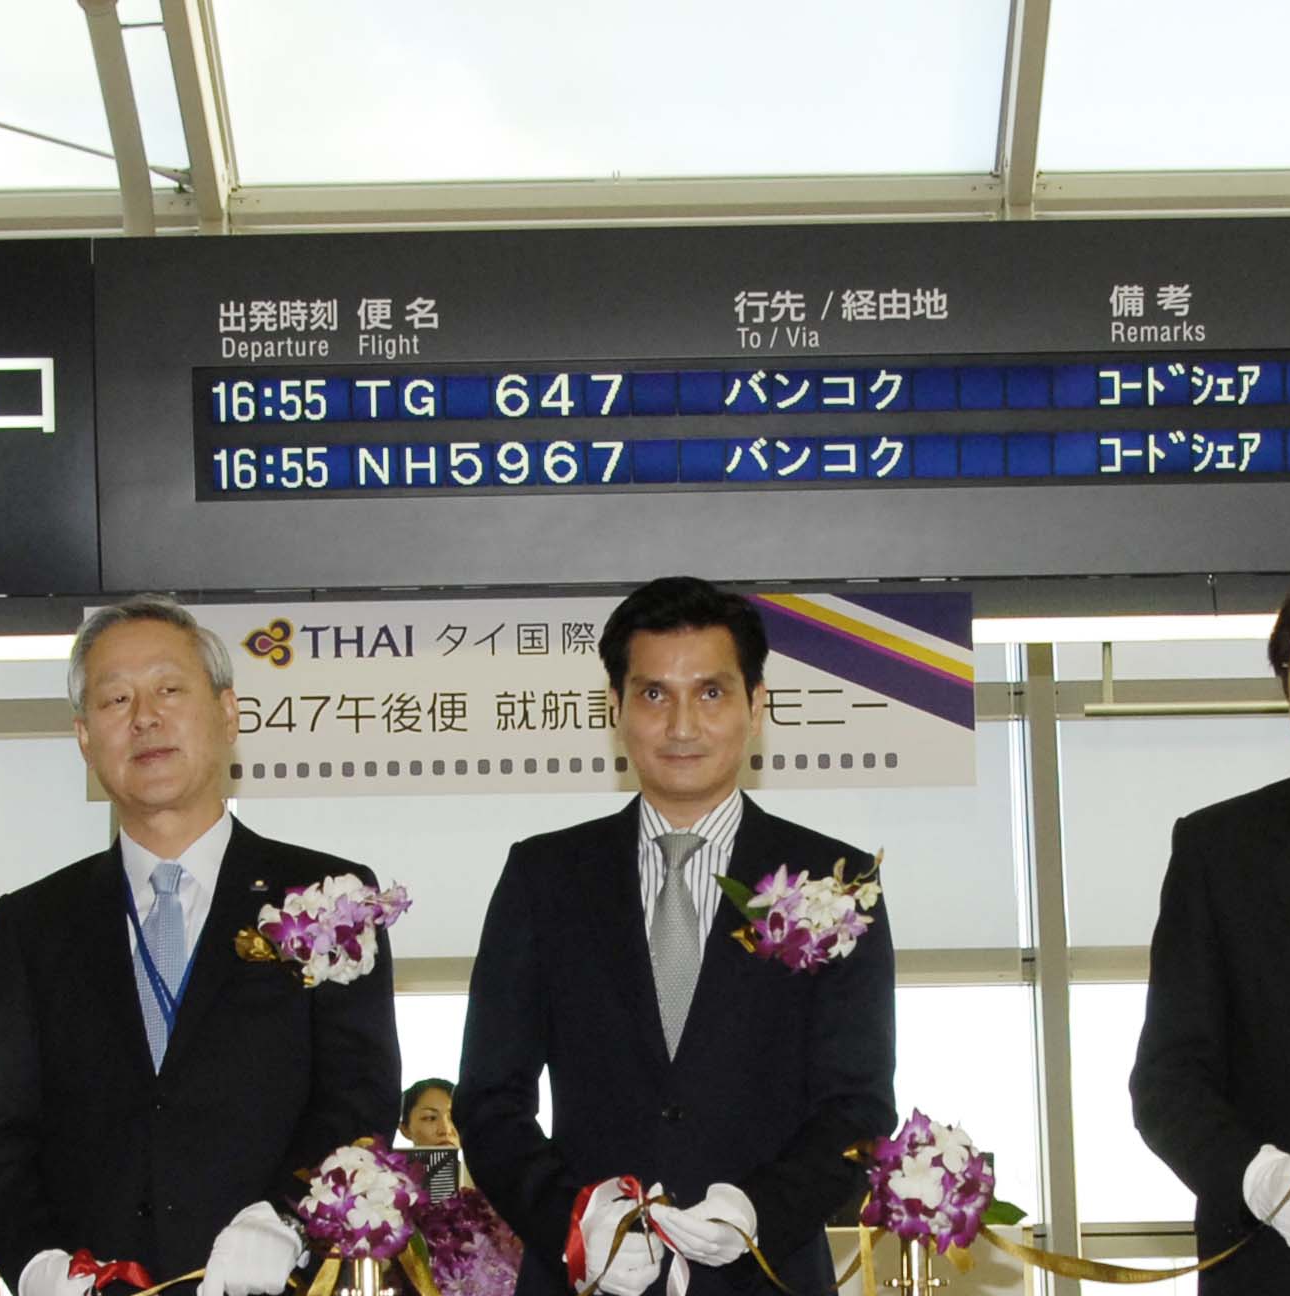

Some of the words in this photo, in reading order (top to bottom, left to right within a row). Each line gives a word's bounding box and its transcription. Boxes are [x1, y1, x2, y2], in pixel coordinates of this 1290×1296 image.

[220, 299, 338, 332] 出発時刻
[1111, 320, 1206, 343] Remarks
[222, 336, 329, 362] Departure
[359, 333, 420, 360] Flight
[737, 328, 761, 349] To
[786, 326, 820, 348] Via
[212, 379, 327, 422] 16:55
[356, 379, 435, 418] TG
[495, 373, 623, 417] 647
[725, 370, 903, 410] バンコク
[214, 447, 328, 489] 16:55
[358, 440, 624, 485] NH5967
[726, 437, 904, 478] バンコク
[300, 624, 414, 659] THAI
[437, 622, 595, 656] タイ国際
